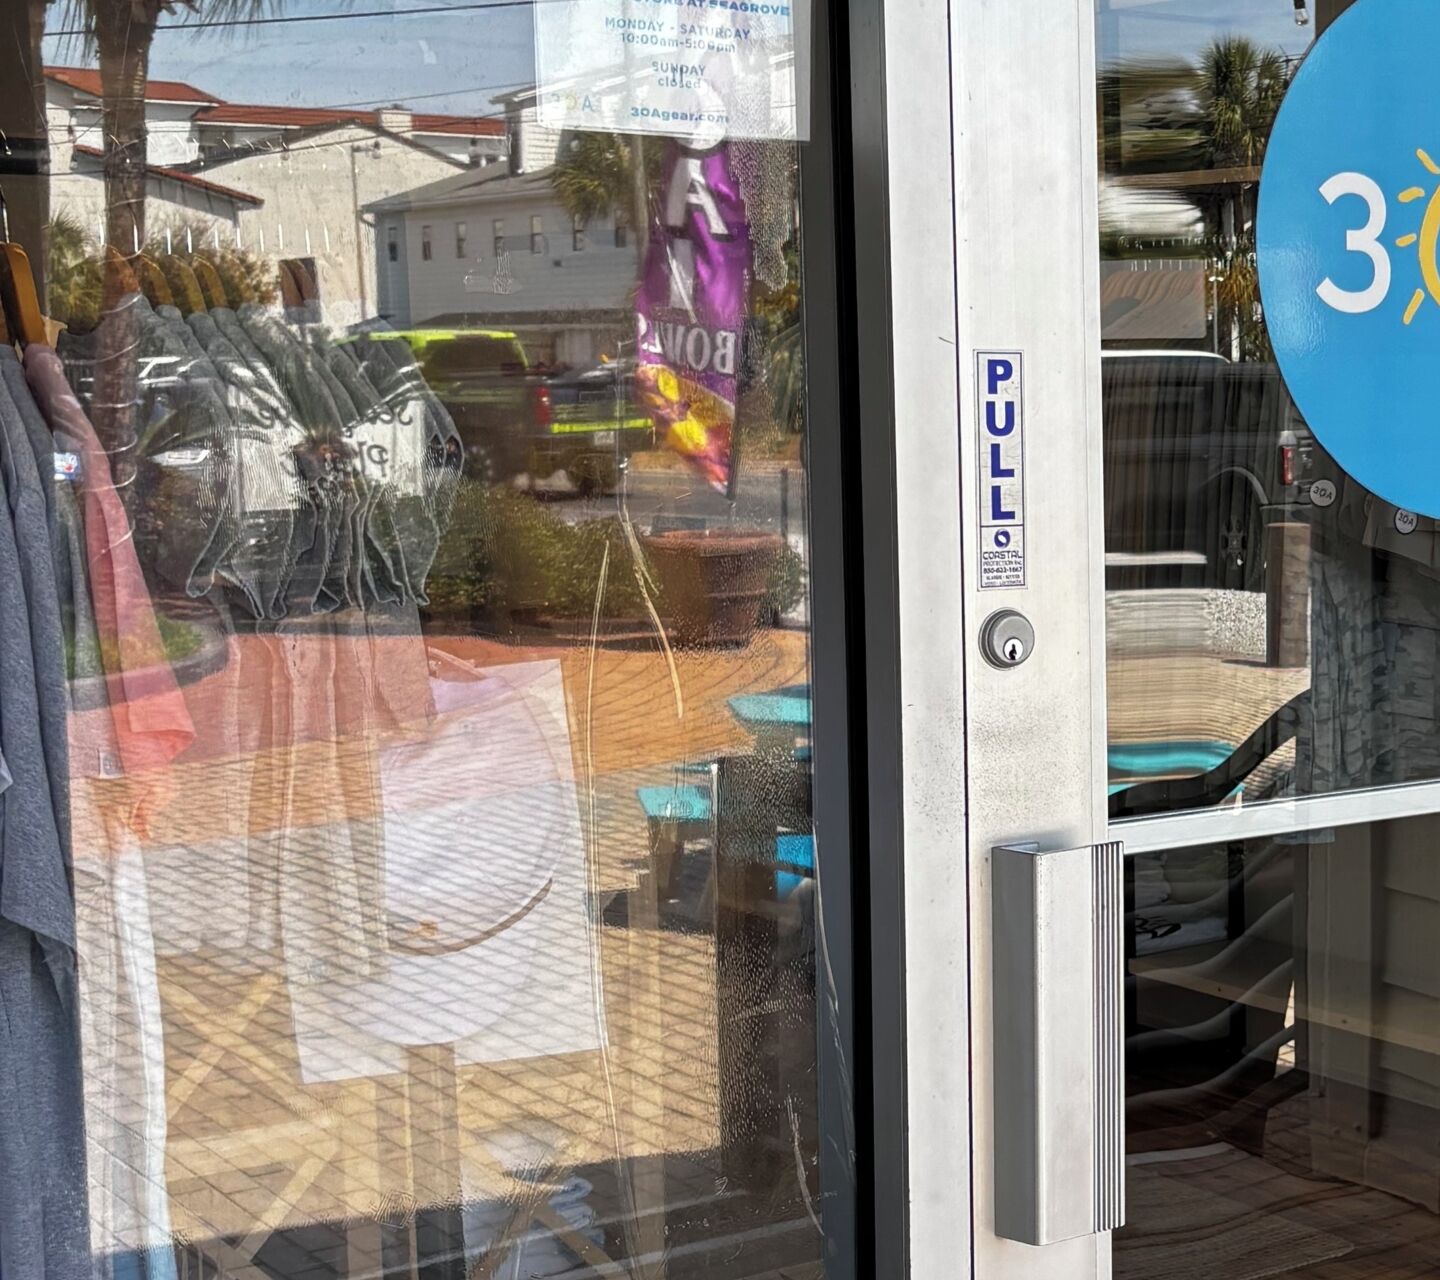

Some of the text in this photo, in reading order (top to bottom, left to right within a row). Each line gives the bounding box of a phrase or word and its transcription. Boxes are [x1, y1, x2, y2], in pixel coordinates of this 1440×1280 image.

[709, 0, 790, 16] SEAGROVE
[605, 16, 665, 32] MONDAY
[680, 23, 750, 40] SATURDAY
[652, 60, 706, 76] SUNDAY
[657, 76, 701, 89] closed
[631, 106, 730, 123] 30Agear.com
[985, 359, 1016, 521] PULL
[1312, 485, 1333, 500] 30A
